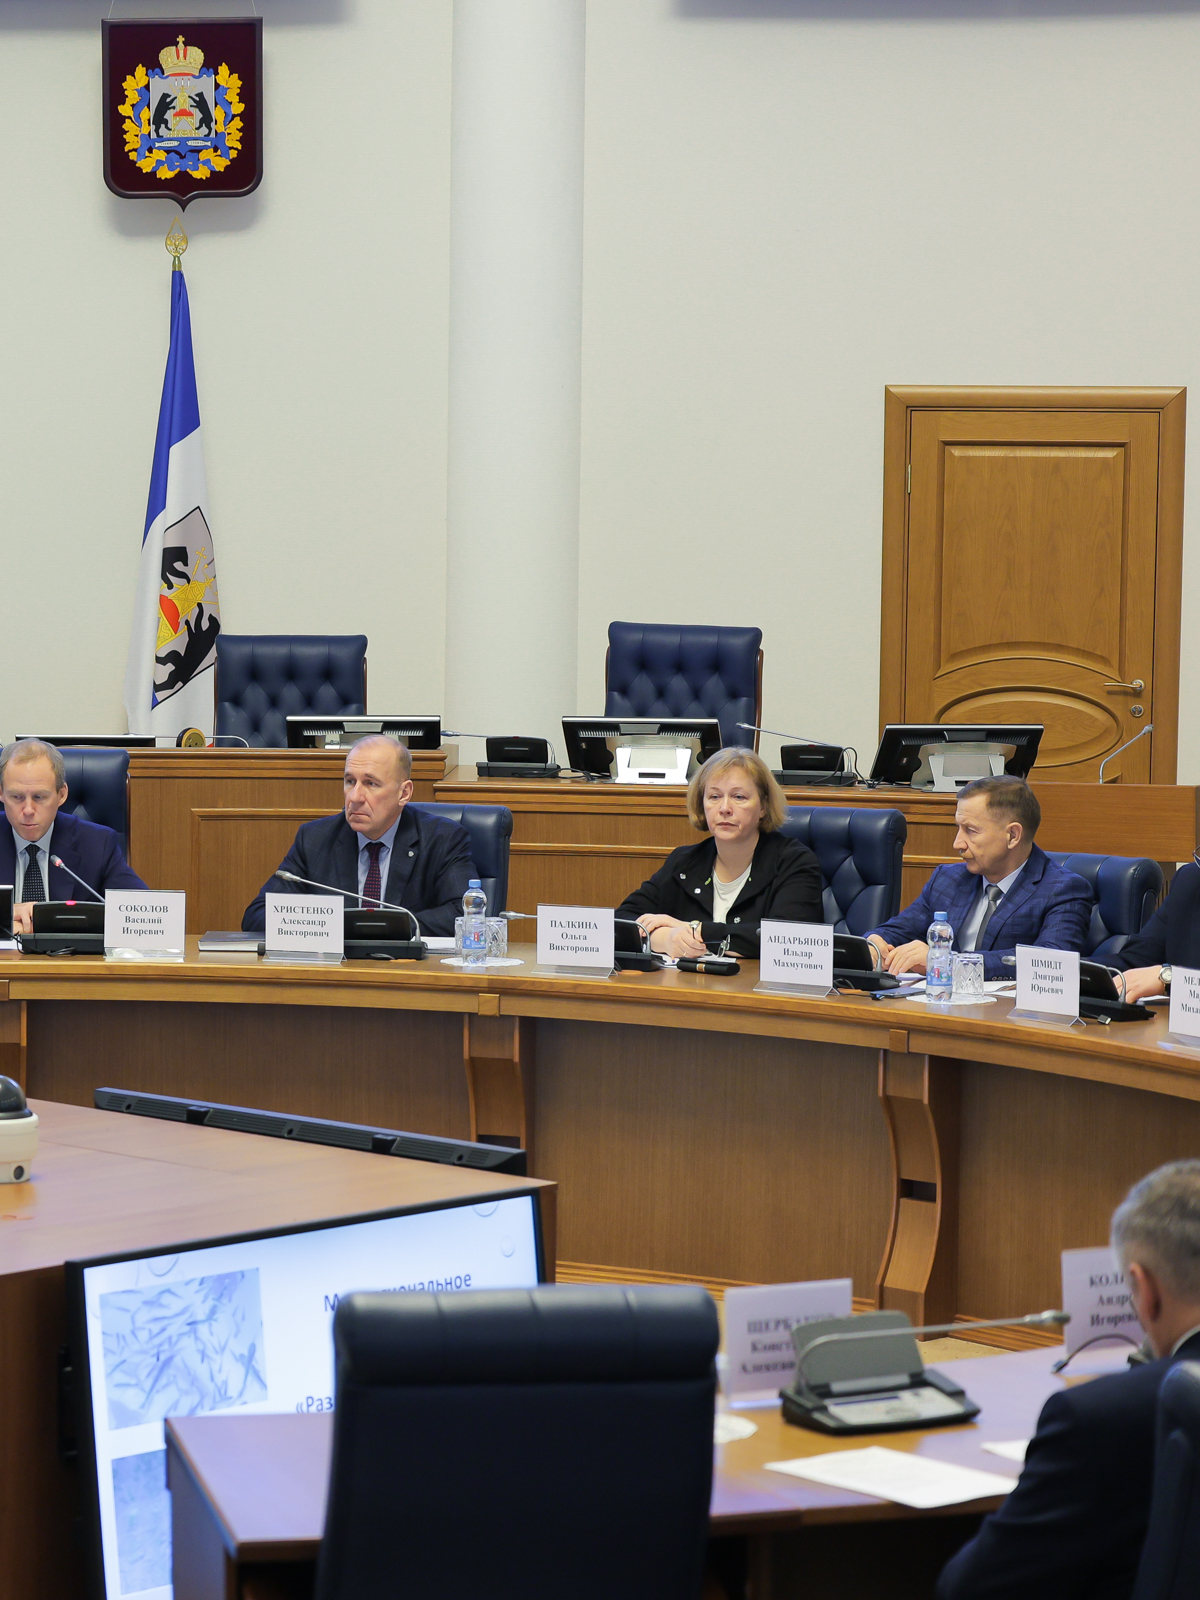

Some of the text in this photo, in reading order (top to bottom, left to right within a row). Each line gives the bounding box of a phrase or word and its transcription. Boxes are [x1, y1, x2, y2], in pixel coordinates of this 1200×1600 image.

[118, 904, 169, 914] СОКОЛОВ
[273, 904, 334, 916] ХРИСТЕНКО
[124, 914, 162, 925] Василий
[280, 917, 326, 928] Александр
[550, 919, 598, 930] ПАЛКИНА
[122, 926, 164, 937] Игоревич
[277, 928, 330, 938] Викторович
[560, 931, 587, 943] Ольга
[767, 934, 830, 948] АНДАРЬЯНОВ
[549, 942, 600, 954] Викторовна
[782, 948, 813, 961] Ильдар
[772, 959, 824, 971] Махмутович
[1031, 959, 1062, 970] ШМИДТ
[1032, 971, 1064, 983] Дмитрий
[1031, 983, 1064, 995] Юрьевич
[1189, 989, 1200, 1001] Ма
